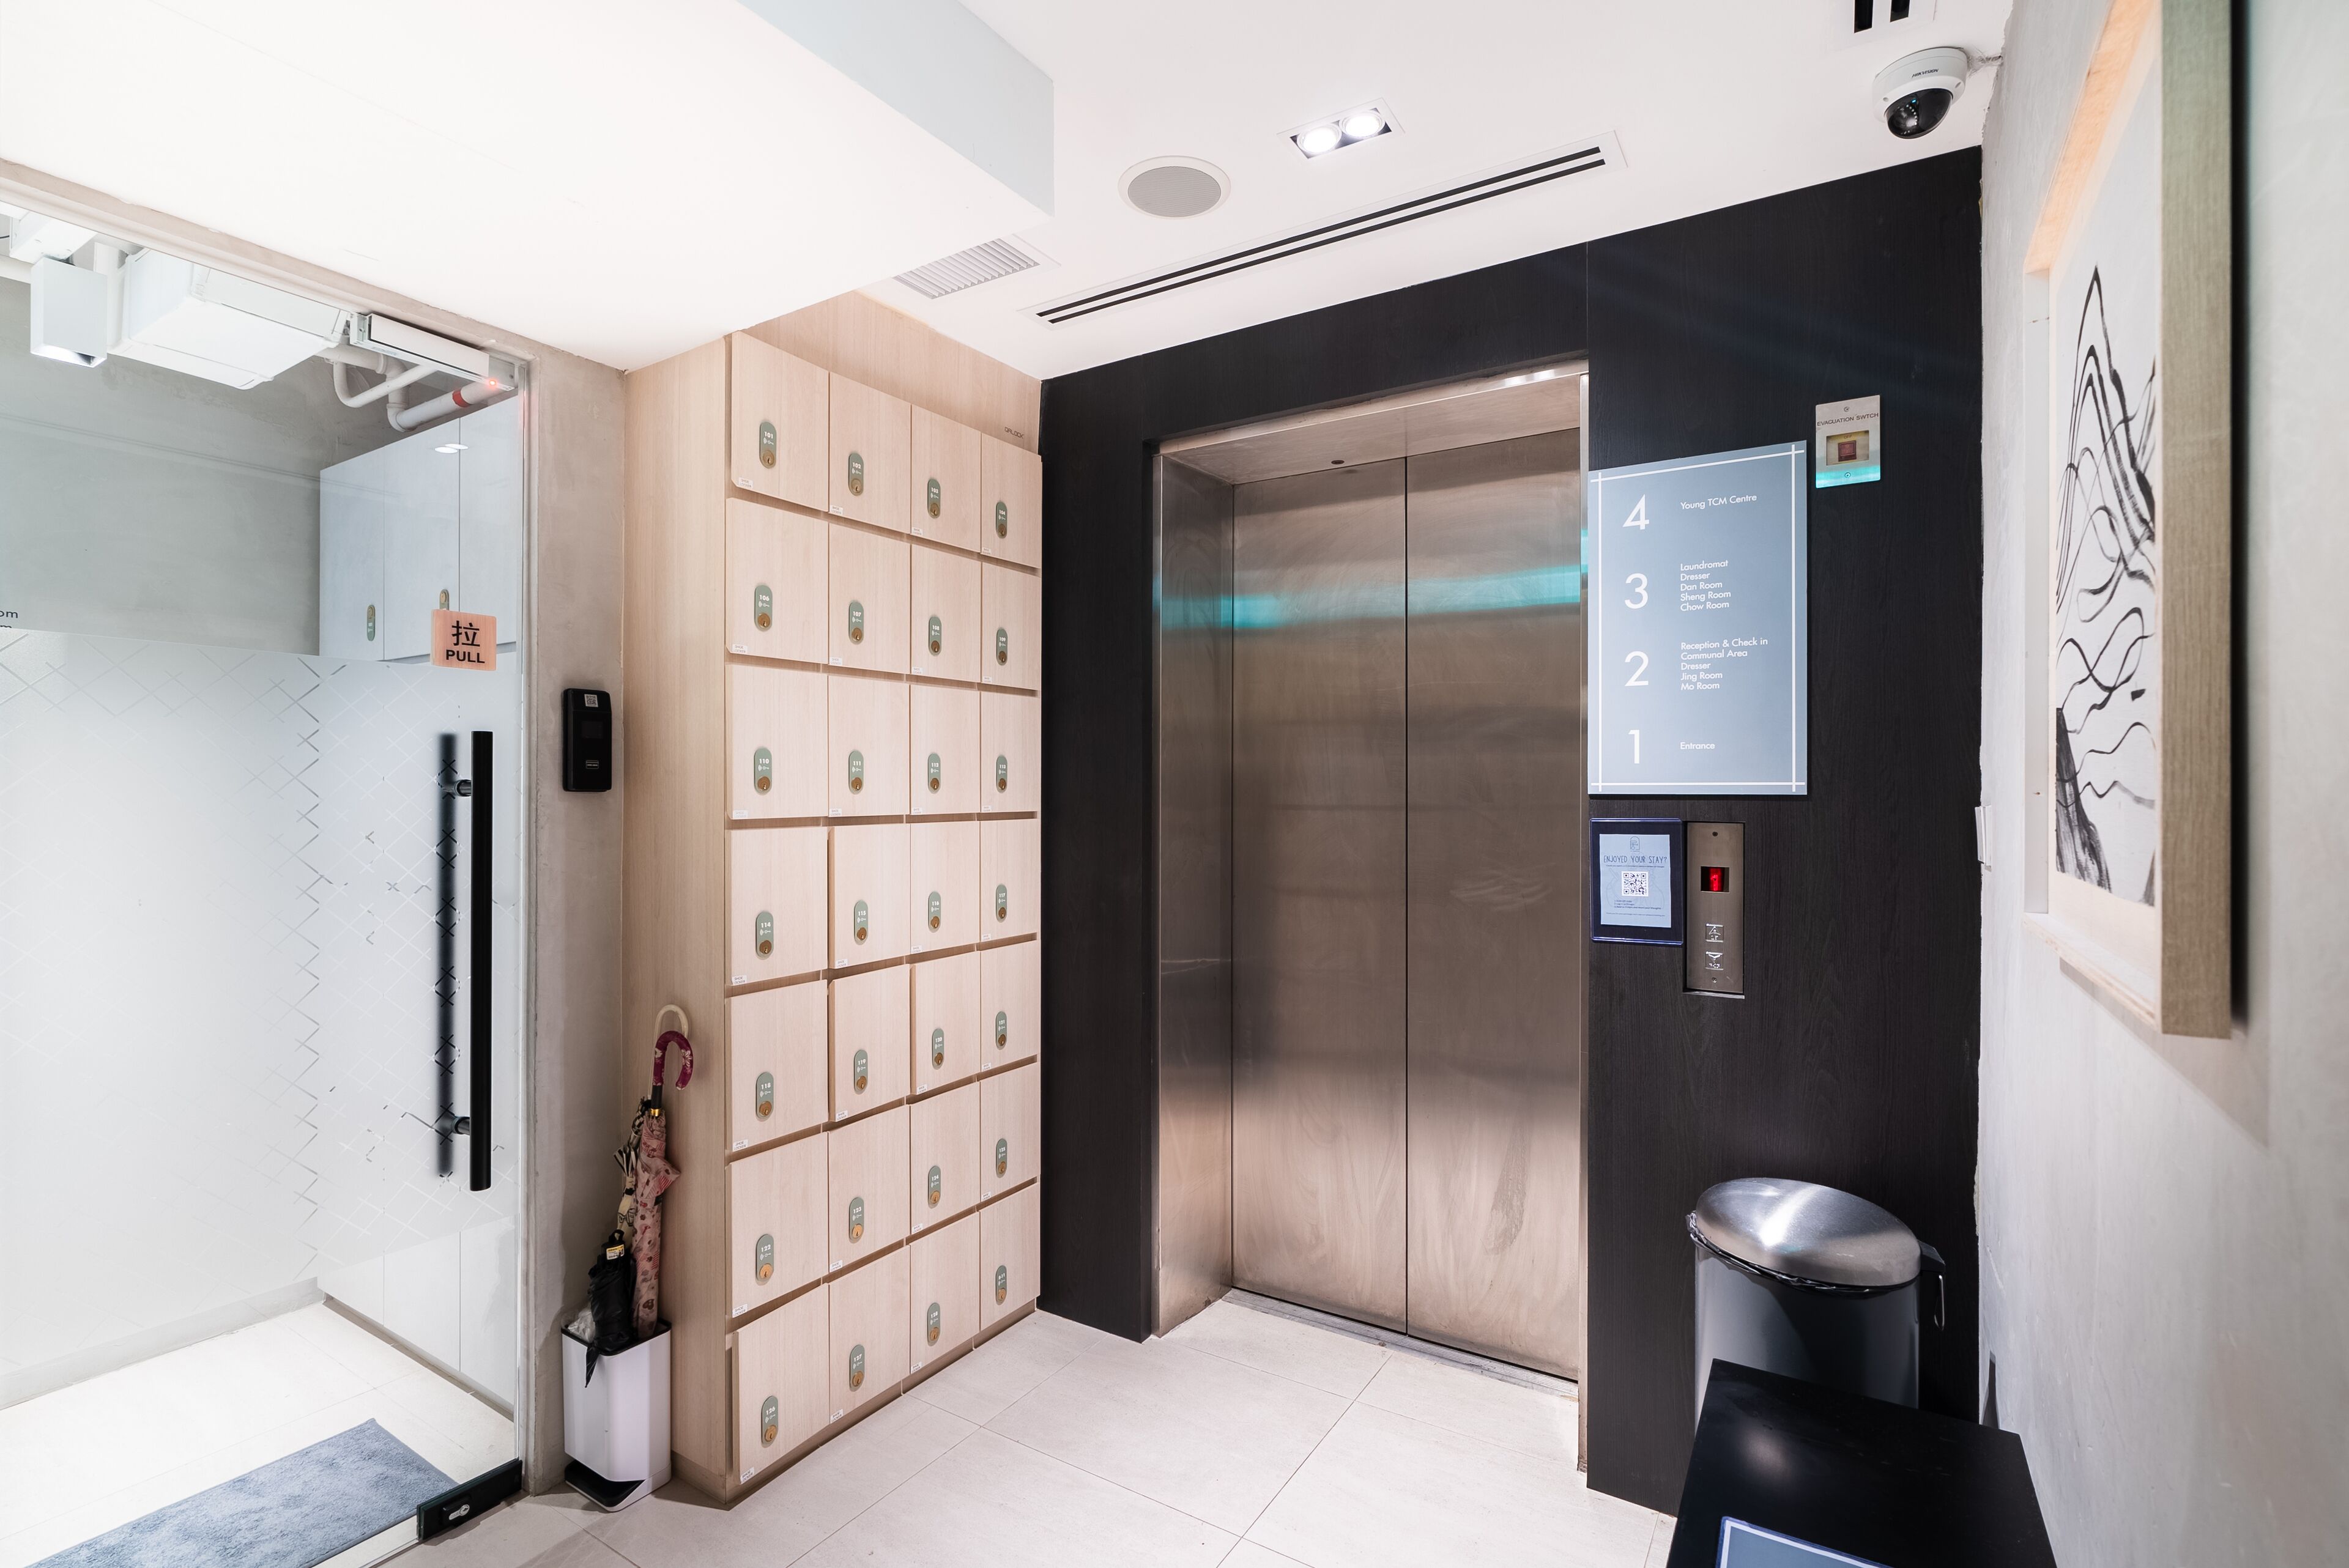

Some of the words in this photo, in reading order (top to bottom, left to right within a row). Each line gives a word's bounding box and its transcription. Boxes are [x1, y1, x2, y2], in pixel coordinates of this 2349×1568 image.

[1912, 68, 1939, 78] HIKVISION
[1817, 416, 1854, 426] EVACUATION
[1729, 495, 1757, 504] Centre
[1623, 494, 1649, 530] 4
[1680, 560, 1729, 571] Laundromat
[1680, 572, 1710, 581] Dresser
[1625, 573, 1648, 609] 3
[1680, 591, 1705, 602] Sheng
[1708, 591, 1731, 599] Room
[1680, 602, 1704, 612] Chow
[1706, 601, 1729, 610] Room
[451, 620, 480, 646] 拉
[1681, 642, 1720, 652] Reception
[1722, 639, 1730, 648] &
[1732, 637, 1758, 647] Check
[1761, 637, 1768, 645] in
[445, 649, 485, 664] PULL
[1680, 649, 1724, 660] Communal
[1726, 649, 1748, 658] Area
[1625, 651, 1649, 686] 2
[1680, 662, 1711, 670] Dresser
[1680, 671, 1698, 681] Jing
[1699, 671, 1723, 679] Room
[1628, 730, 1640, 764] 1
[1680, 741, 1715, 750] Entrance
[766, 1407, 775, 1415] 126
